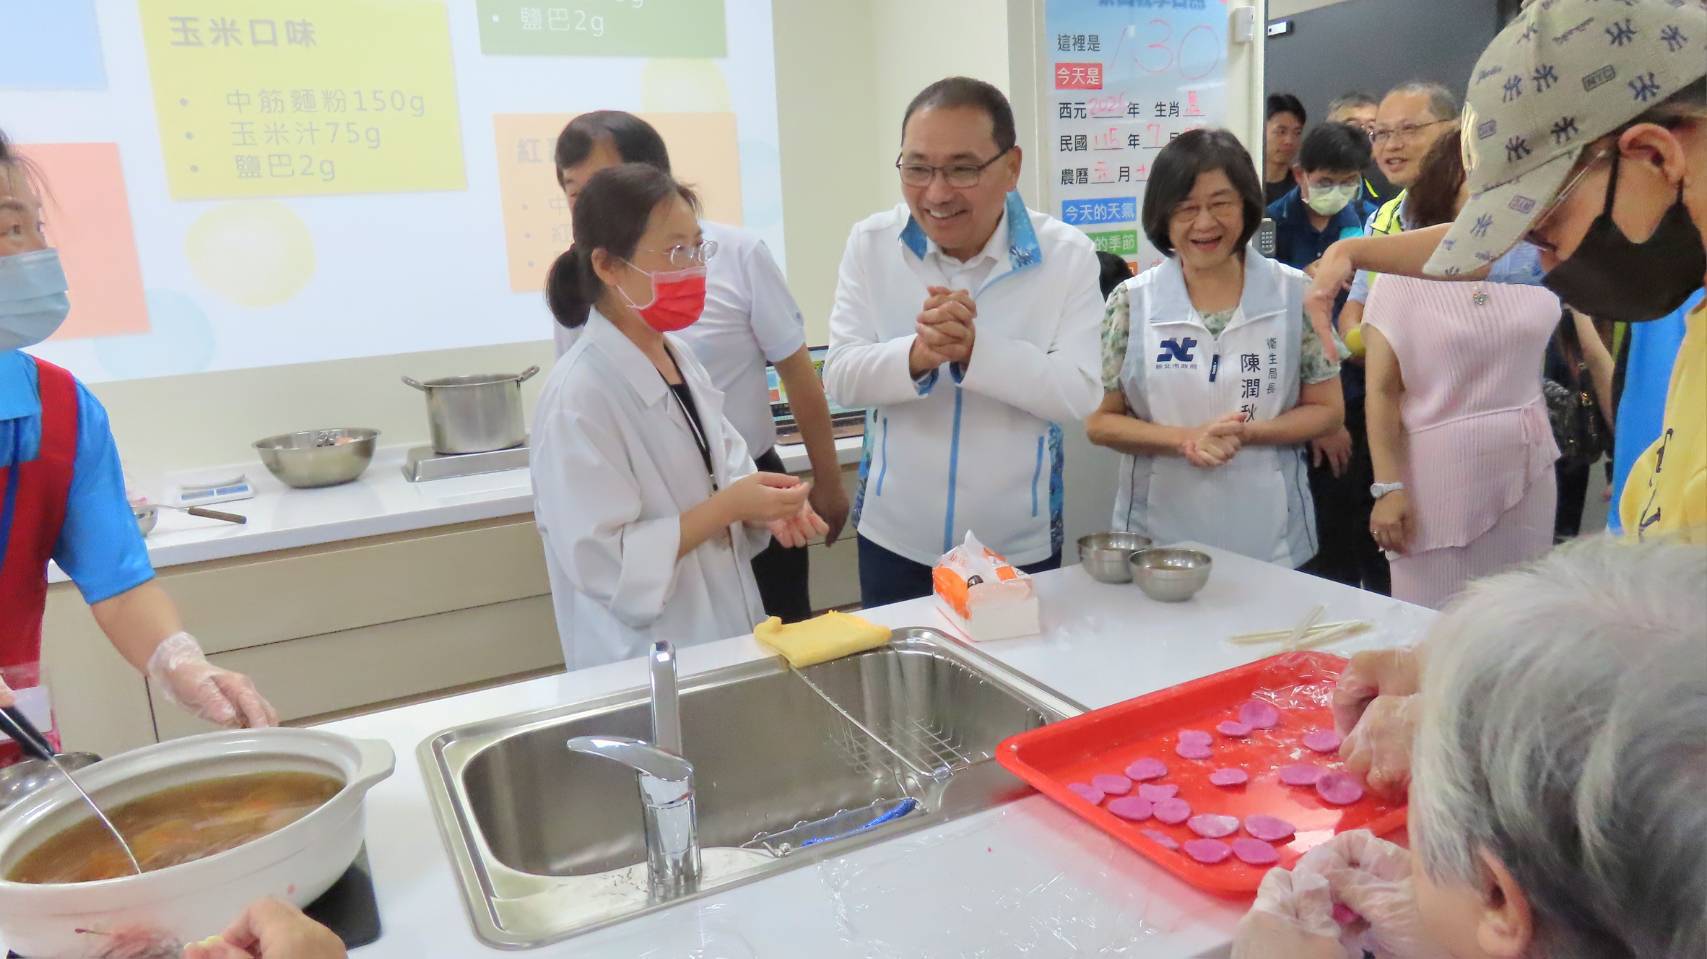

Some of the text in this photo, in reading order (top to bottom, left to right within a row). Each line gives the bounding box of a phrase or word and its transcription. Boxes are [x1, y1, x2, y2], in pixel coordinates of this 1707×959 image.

[168, 15, 317, 48] 玉米口味
[520, 7, 605, 37] 鹽巴2g
[1057, 34, 1101, 52] 這裡是
[1057, 67, 1101, 86] 今天是
[226, 88, 426, 118] 中筋麵粉150g
[1058, 102, 1087, 119] 西元
[1127, 102, 1140, 118] 年
[1155, 102, 1180, 118] 生肖
[230, 121, 381, 149] 玉米汁75g
[1060, 134, 1088, 152] 民國
[1127, 134, 1140, 150] 年
[517, 137, 557, 163] 紅
[234, 153, 336, 182] 鹽巴2g
[1061, 167, 1089, 185] 農曆
[1118, 166, 1130, 182] 月
[1065, 202, 1136, 222] 今天的天氣
[1240, 353, 1261, 423] 陳潤秋
